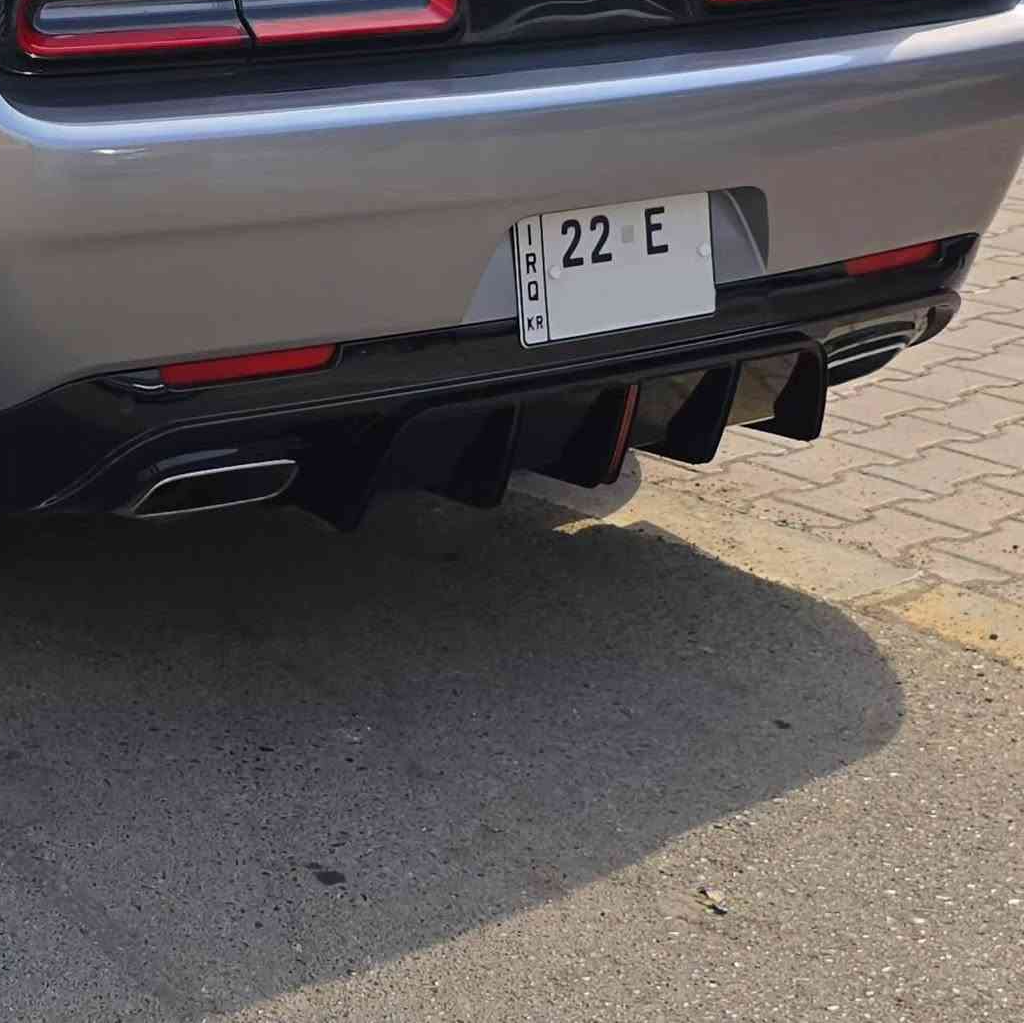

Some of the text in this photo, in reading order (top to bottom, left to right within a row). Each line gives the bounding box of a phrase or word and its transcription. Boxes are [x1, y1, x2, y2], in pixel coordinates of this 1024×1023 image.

[525, 223, 539, 302] IRQ
[560, 206, 669, 269] 22 E
[526, 314, 544, 332] KR
